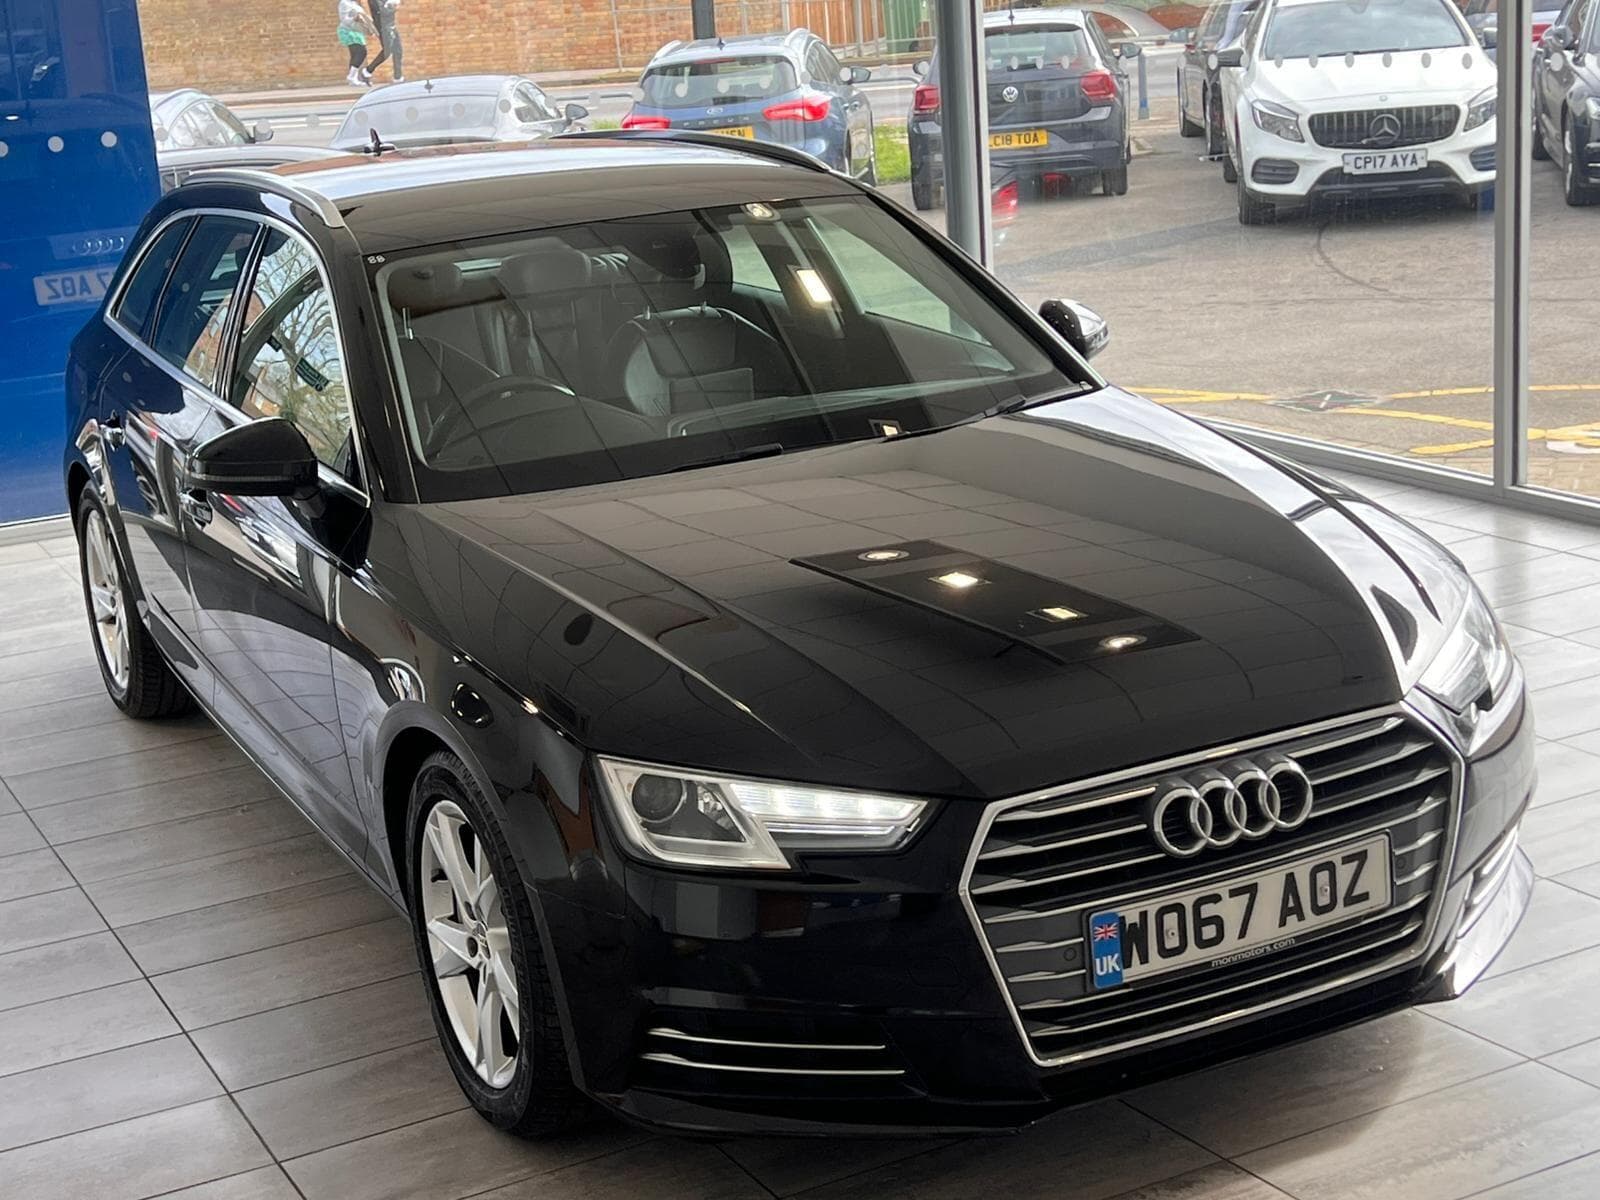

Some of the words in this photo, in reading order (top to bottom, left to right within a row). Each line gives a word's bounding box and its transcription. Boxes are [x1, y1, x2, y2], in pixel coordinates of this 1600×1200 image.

[989, 134, 1012, 147] C18
[1016, 132, 1039, 144] TOA
[1354, 155, 1386, 169] CP17
[1391, 153, 1418, 168] AYA
[1119, 882, 1258, 970] WO67
[1278, 848, 1370, 928] AOZ
[1095, 952, 1121, 976] UK
[1211, 938, 1296, 967] monmotors.com
